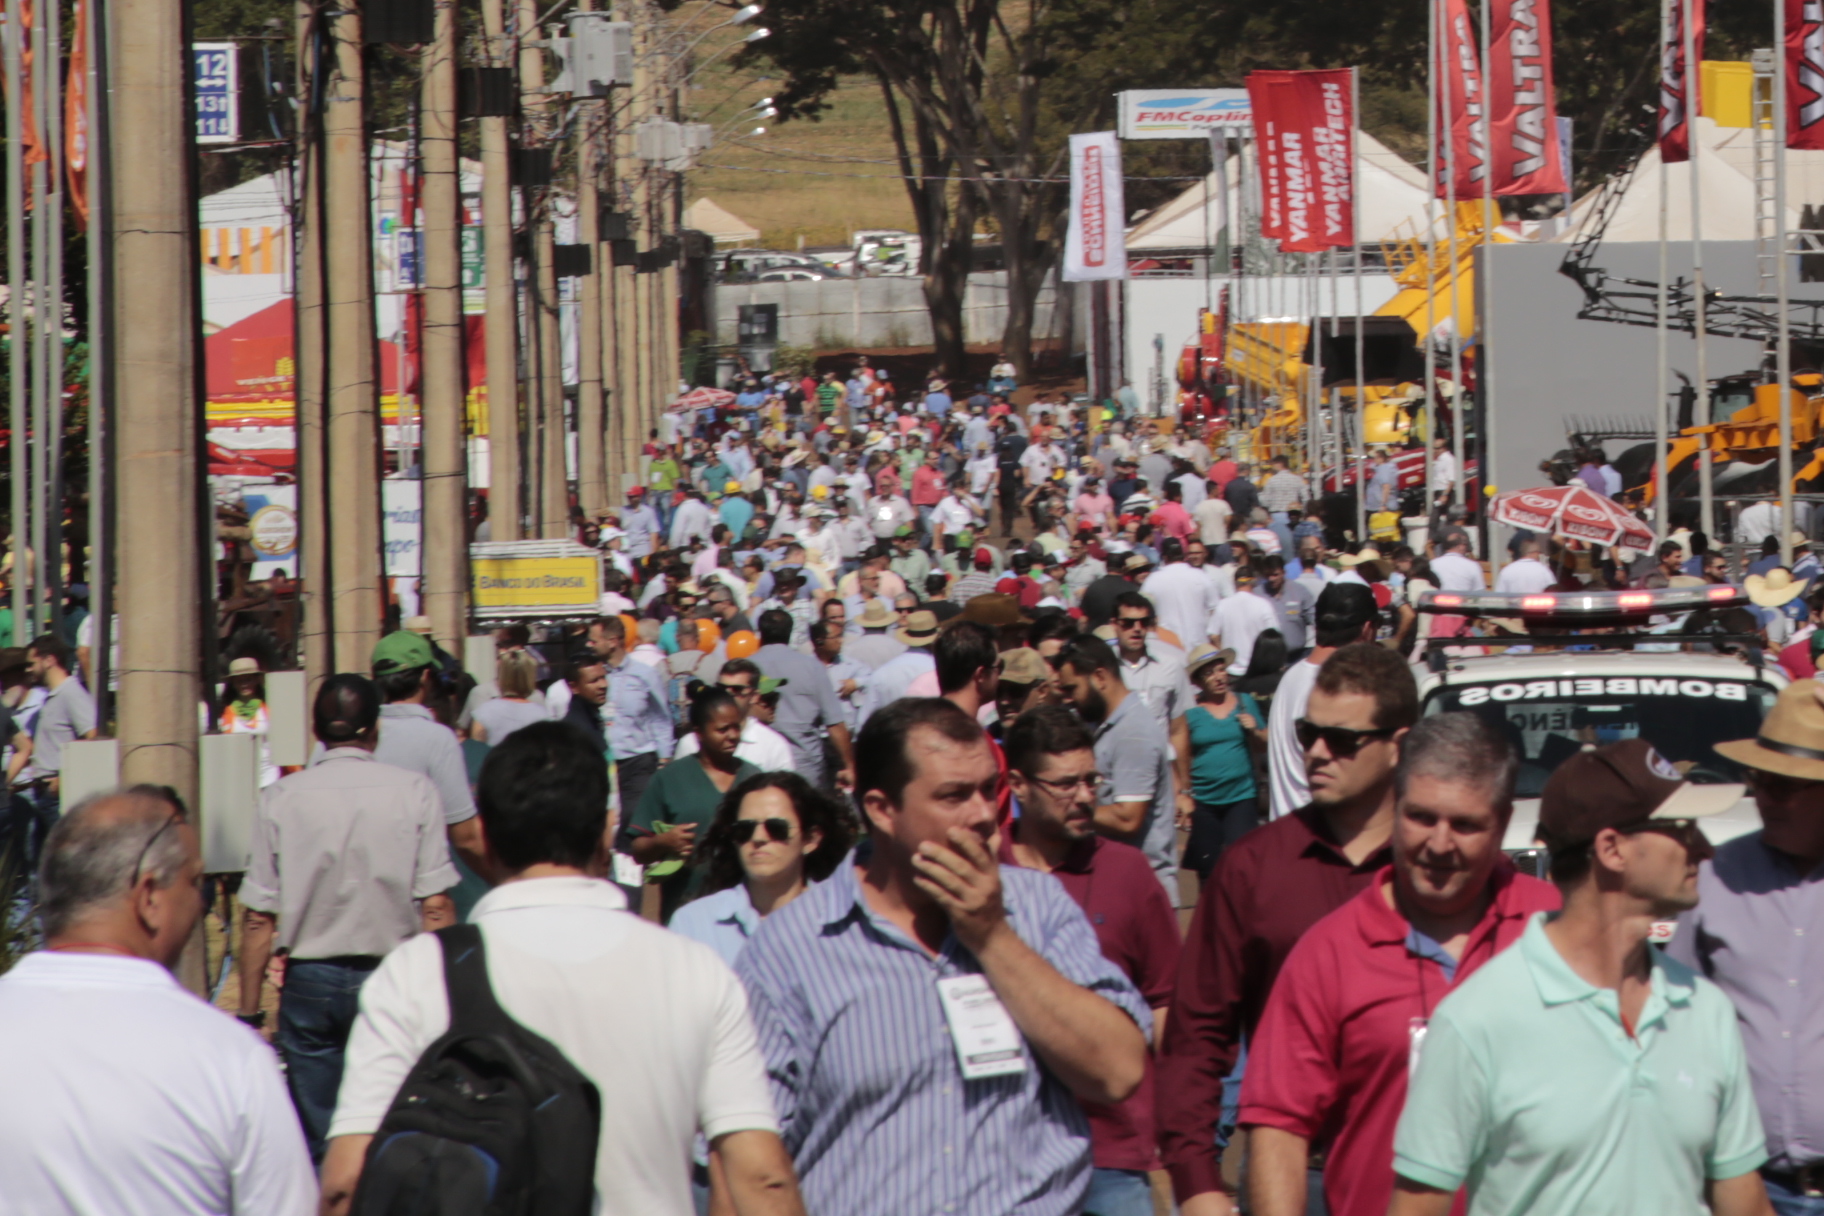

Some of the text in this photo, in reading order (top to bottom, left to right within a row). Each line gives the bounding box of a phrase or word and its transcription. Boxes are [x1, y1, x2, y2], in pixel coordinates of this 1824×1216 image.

[195, 53, 228, 76] 12
[194, 95, 219, 112] 13
[194, 117, 218, 134] 11
[1135, 111, 1254, 123] FMCoplin
[1281, 132, 1309, 243] YANMAR
[1312, 127, 1342, 237] YANMAR
